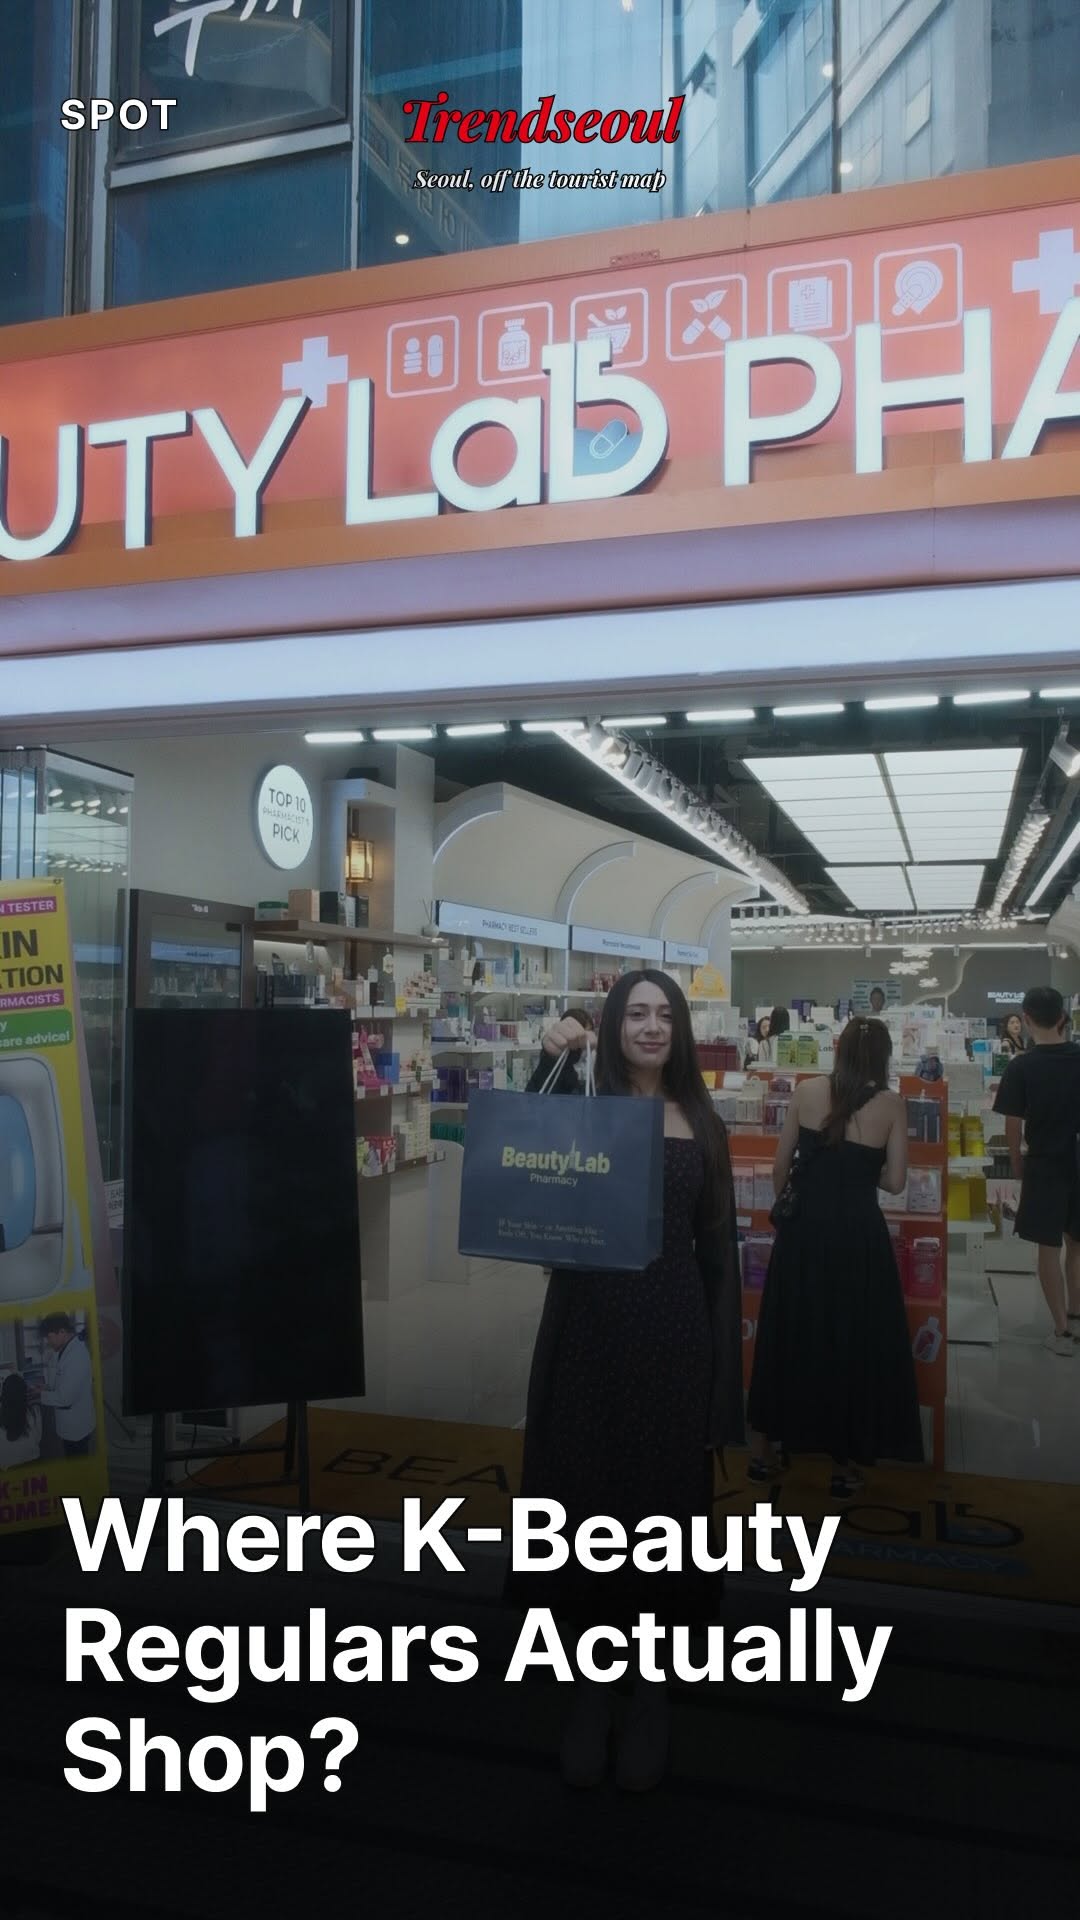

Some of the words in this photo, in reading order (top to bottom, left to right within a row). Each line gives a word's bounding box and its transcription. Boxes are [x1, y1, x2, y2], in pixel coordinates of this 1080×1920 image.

[346, 339, 668, 525] Lab
[269, 787, 293, 808] TOP
[296, 795, 305, 813] 10
[272, 822, 300, 844] PICK
[7, 899, 54, 913] TESTER
[0, 928, 39, 959] IN
[0, 963, 64, 989] TION
[25, 1030, 71, 1046] advice!
[501, 1146, 571, 1175] Beauty
[574, 1151, 611, 1174] Lab
[530, 1172, 578, 1188] Pharmacy
[321, 1449, 508, 1495] BEA
